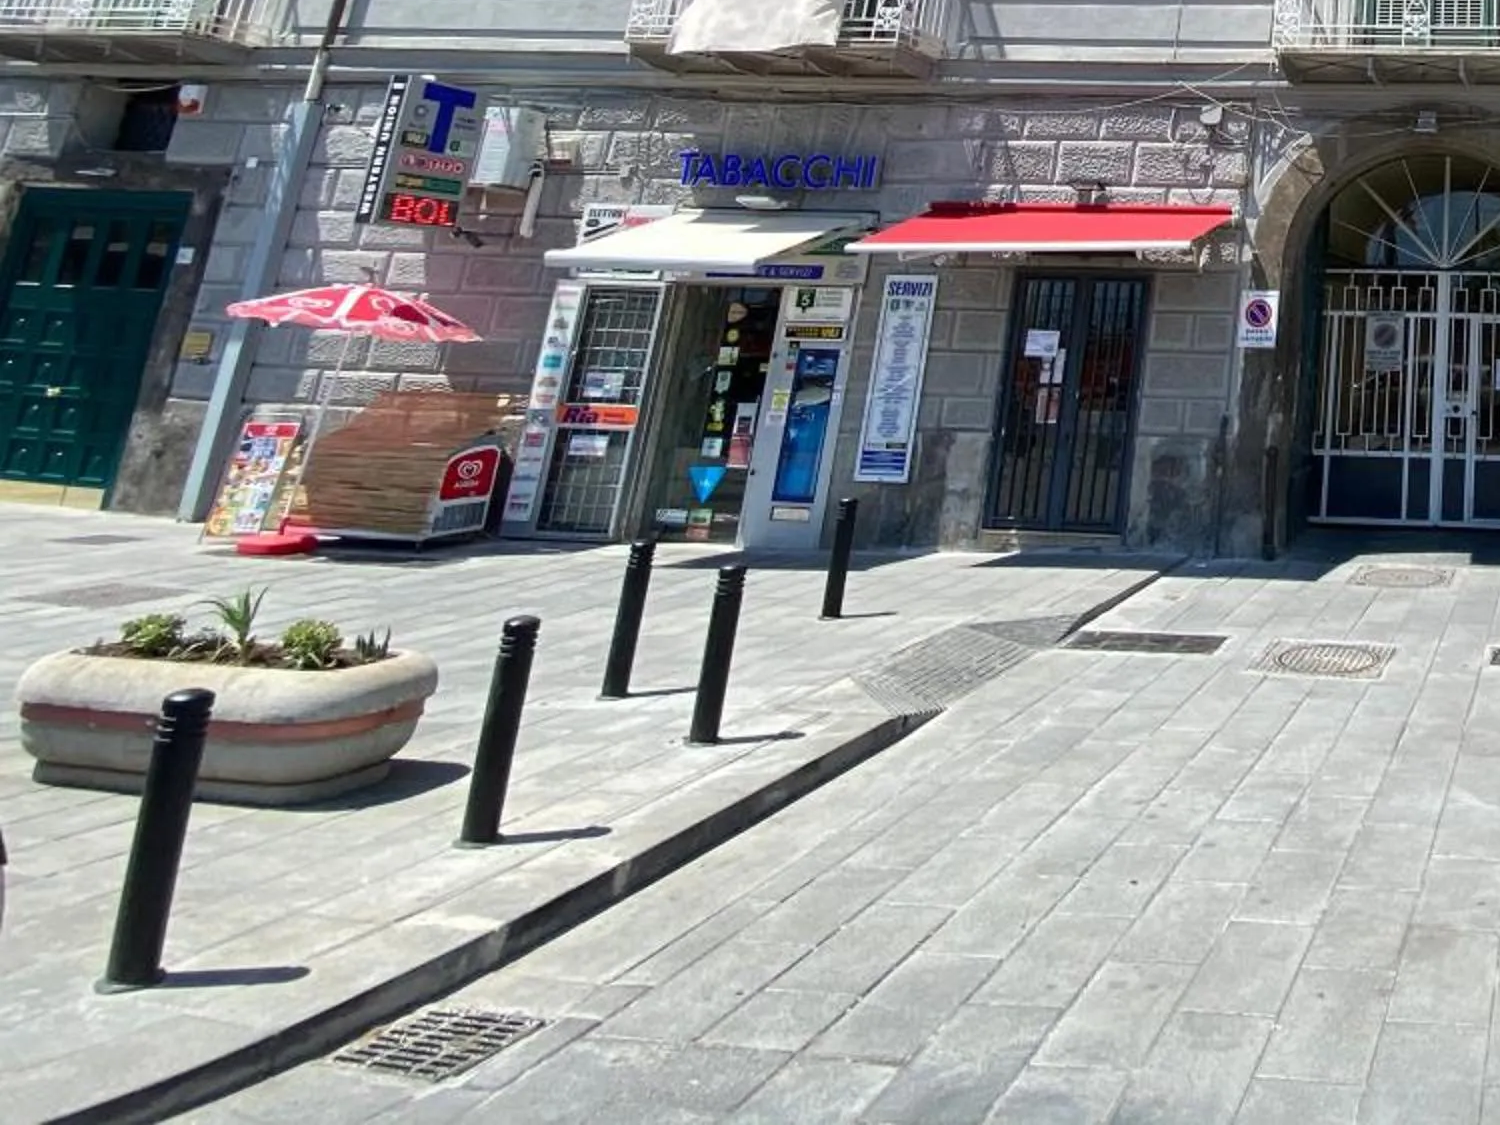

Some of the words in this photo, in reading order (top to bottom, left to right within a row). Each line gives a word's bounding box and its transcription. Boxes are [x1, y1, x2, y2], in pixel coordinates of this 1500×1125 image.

[422, 82, 477, 154] T
[360, 146, 387, 214] WESTERN
[380, 94, 400, 142] UNION
[679, 149, 878, 189] TABACCHI
[887, 281, 933, 296] SERVIZI
[563, 405, 598, 423] Ria
